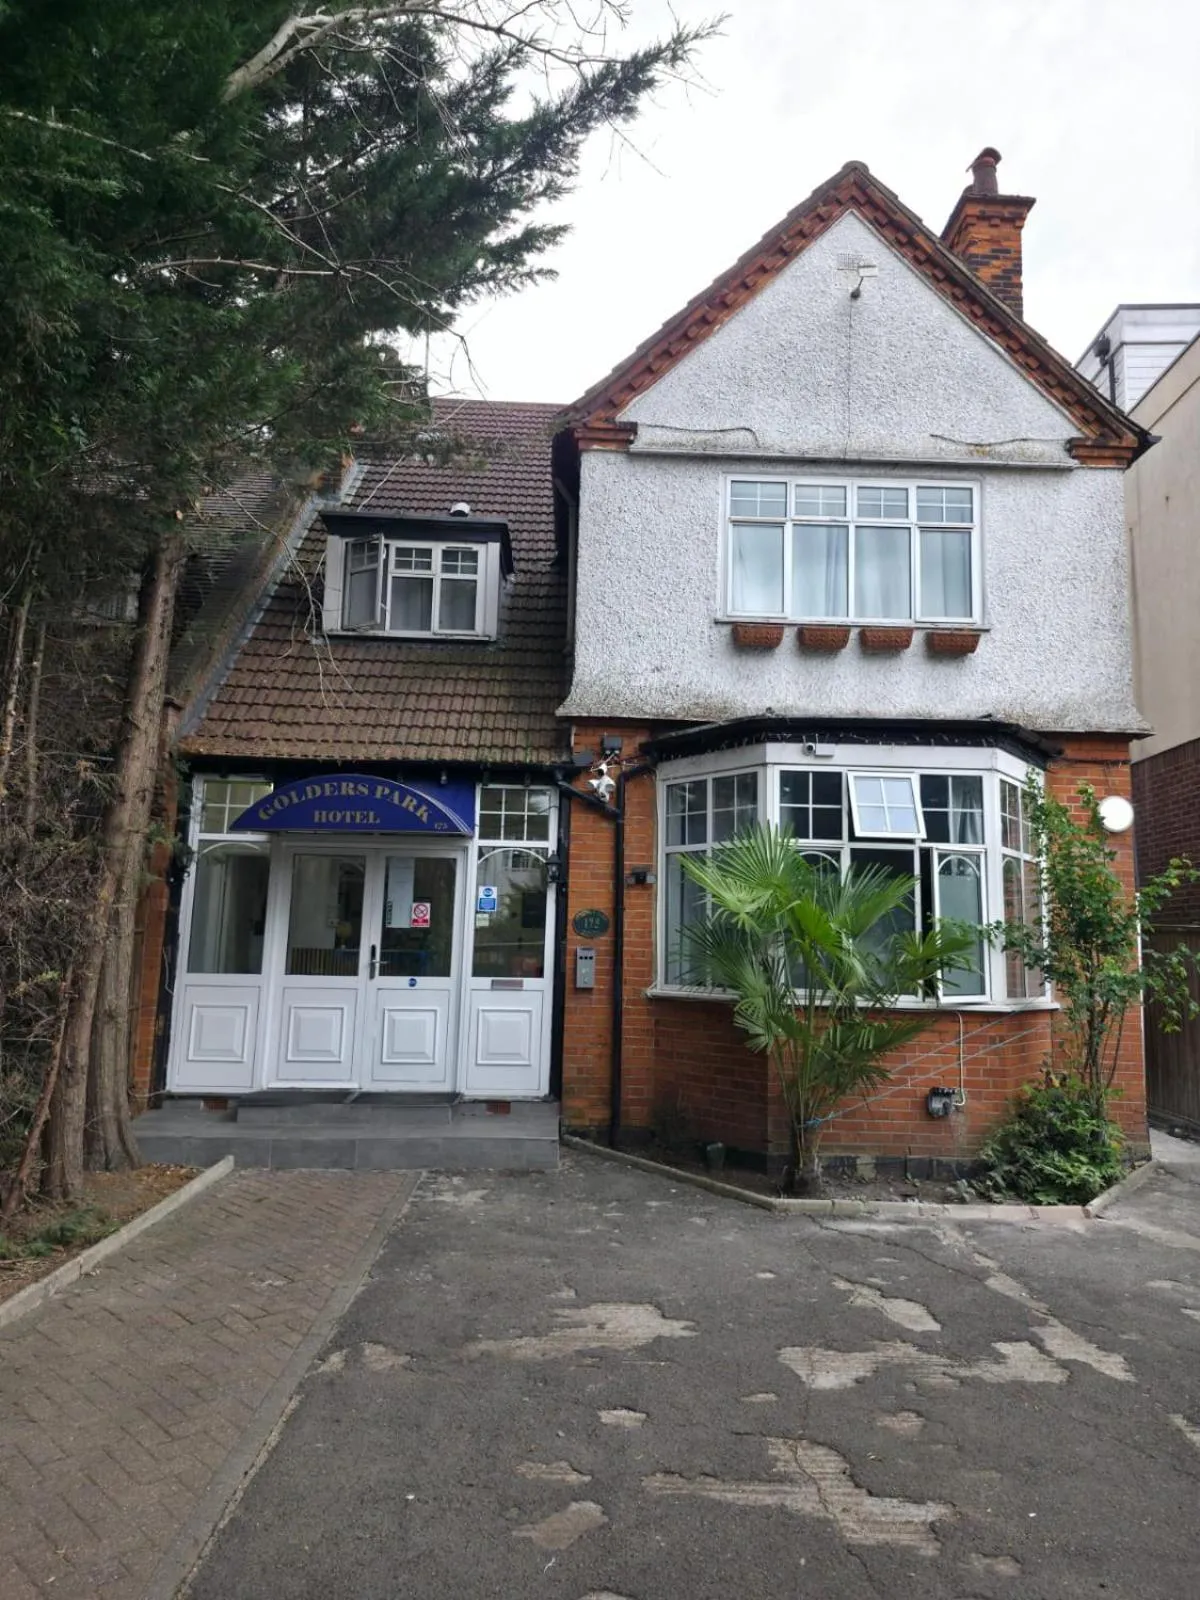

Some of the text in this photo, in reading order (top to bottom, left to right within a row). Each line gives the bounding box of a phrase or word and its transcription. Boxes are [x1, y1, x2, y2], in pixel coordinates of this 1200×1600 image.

[258, 781, 432, 824] GOLDERS PARK
[313, 810, 381, 824] HOTEL
